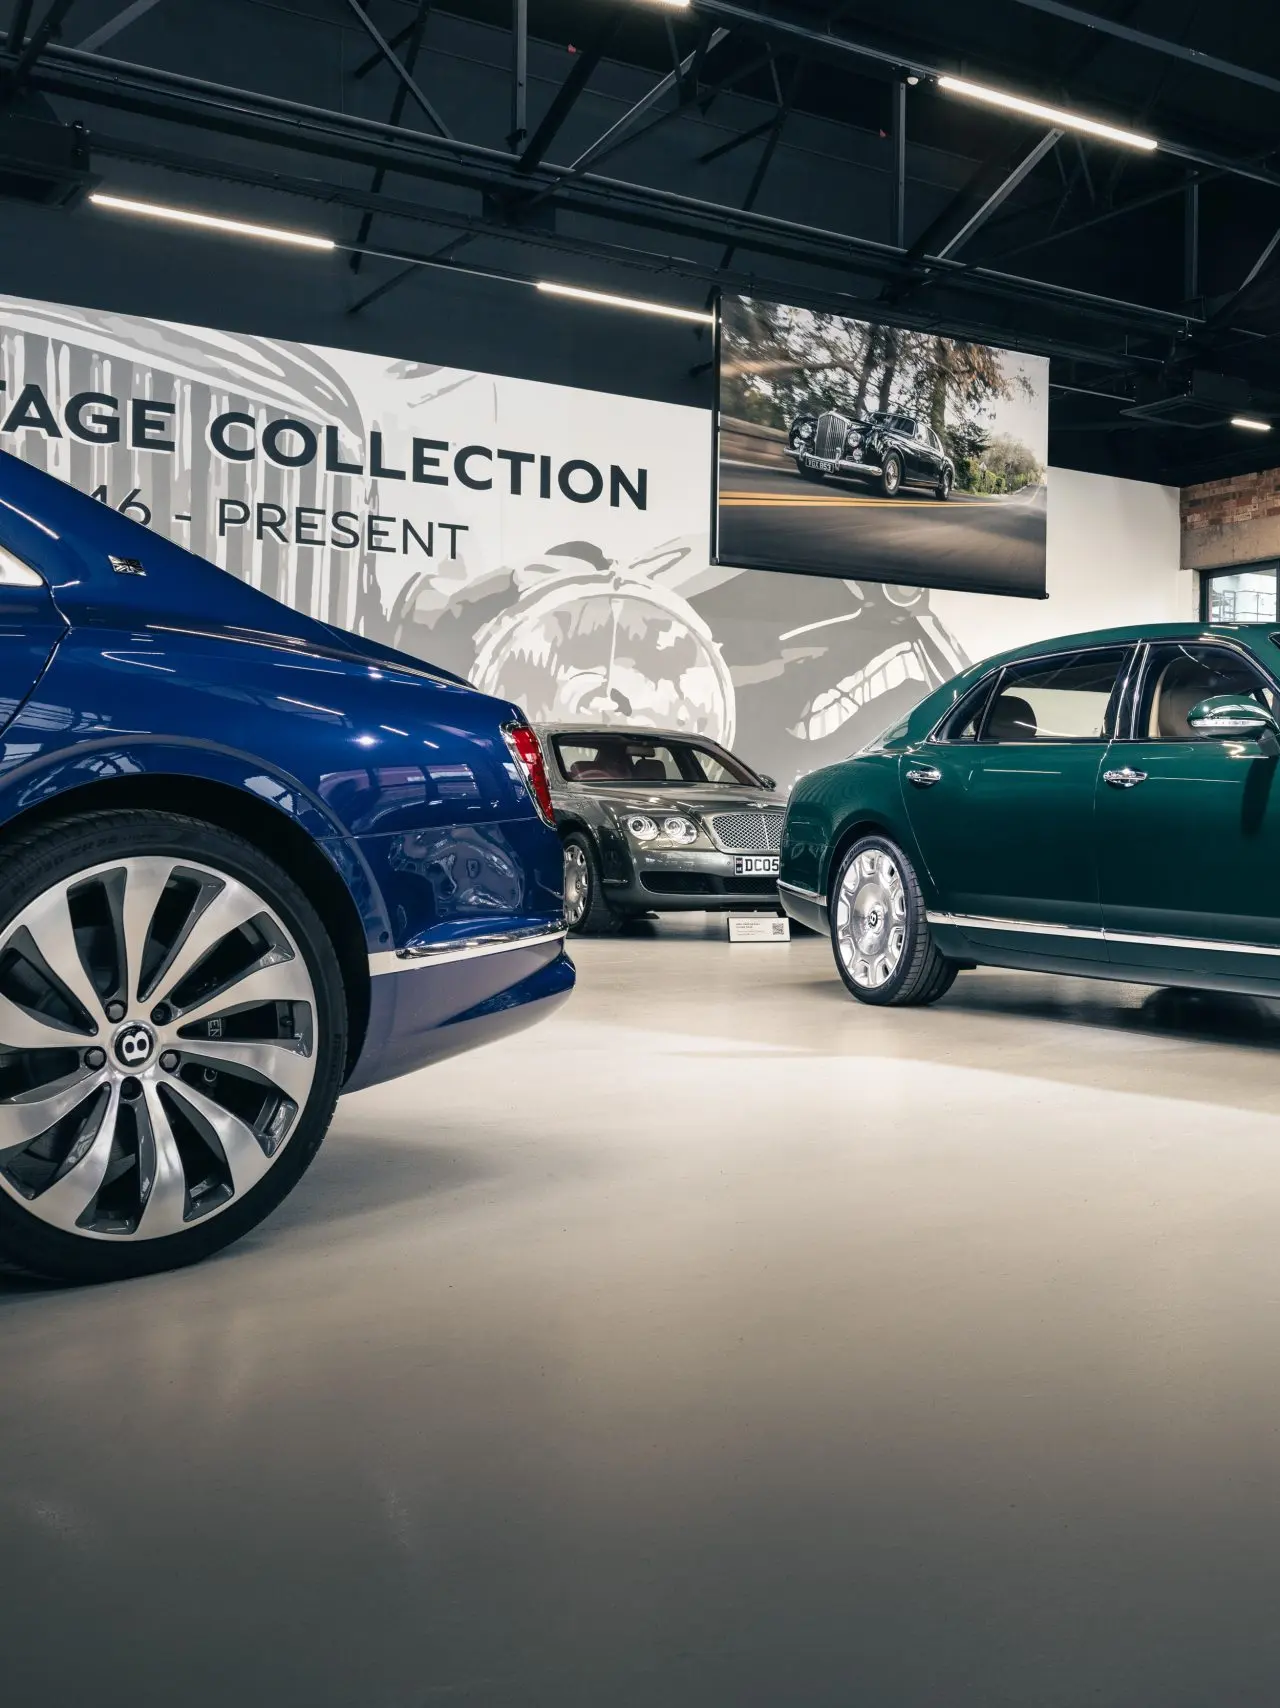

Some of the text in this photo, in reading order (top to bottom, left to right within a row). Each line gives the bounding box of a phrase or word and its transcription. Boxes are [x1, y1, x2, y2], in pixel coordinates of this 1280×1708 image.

[0, 380, 647, 510] AGE COLLECTION
[219, 499, 469, 559] PRESENT
[745, 859, 779, 871] DC05
